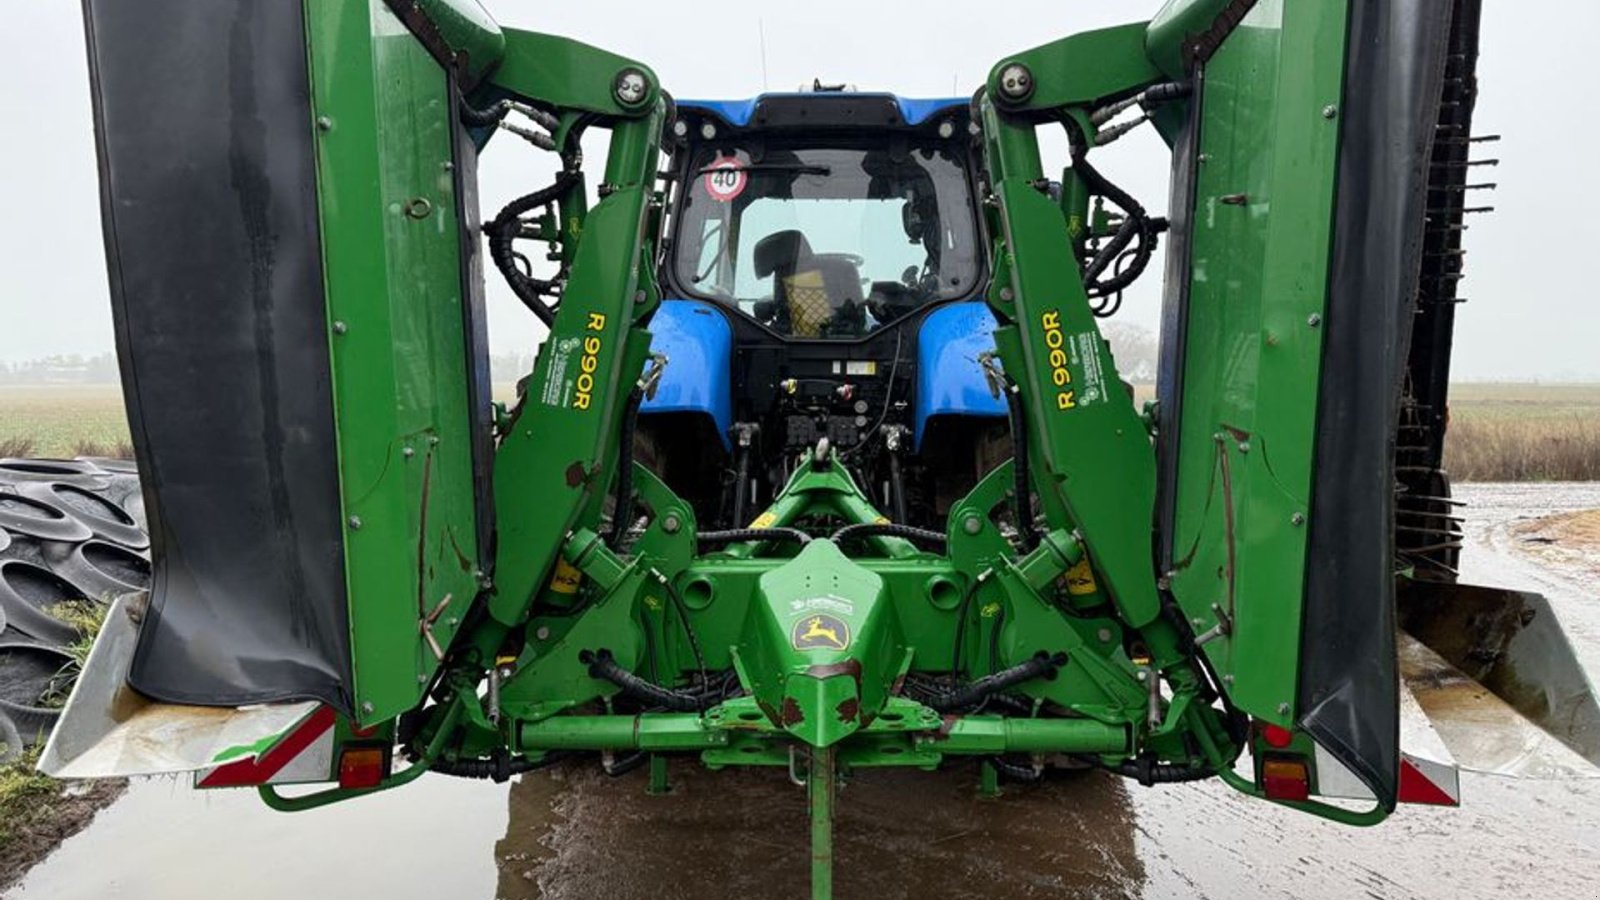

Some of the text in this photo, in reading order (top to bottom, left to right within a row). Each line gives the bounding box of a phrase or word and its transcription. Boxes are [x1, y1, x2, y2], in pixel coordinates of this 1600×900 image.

[713, 169, 736, 187] 40
[572, 312, 606, 410] R 990R
[1042, 311, 1076, 410] R 990R
